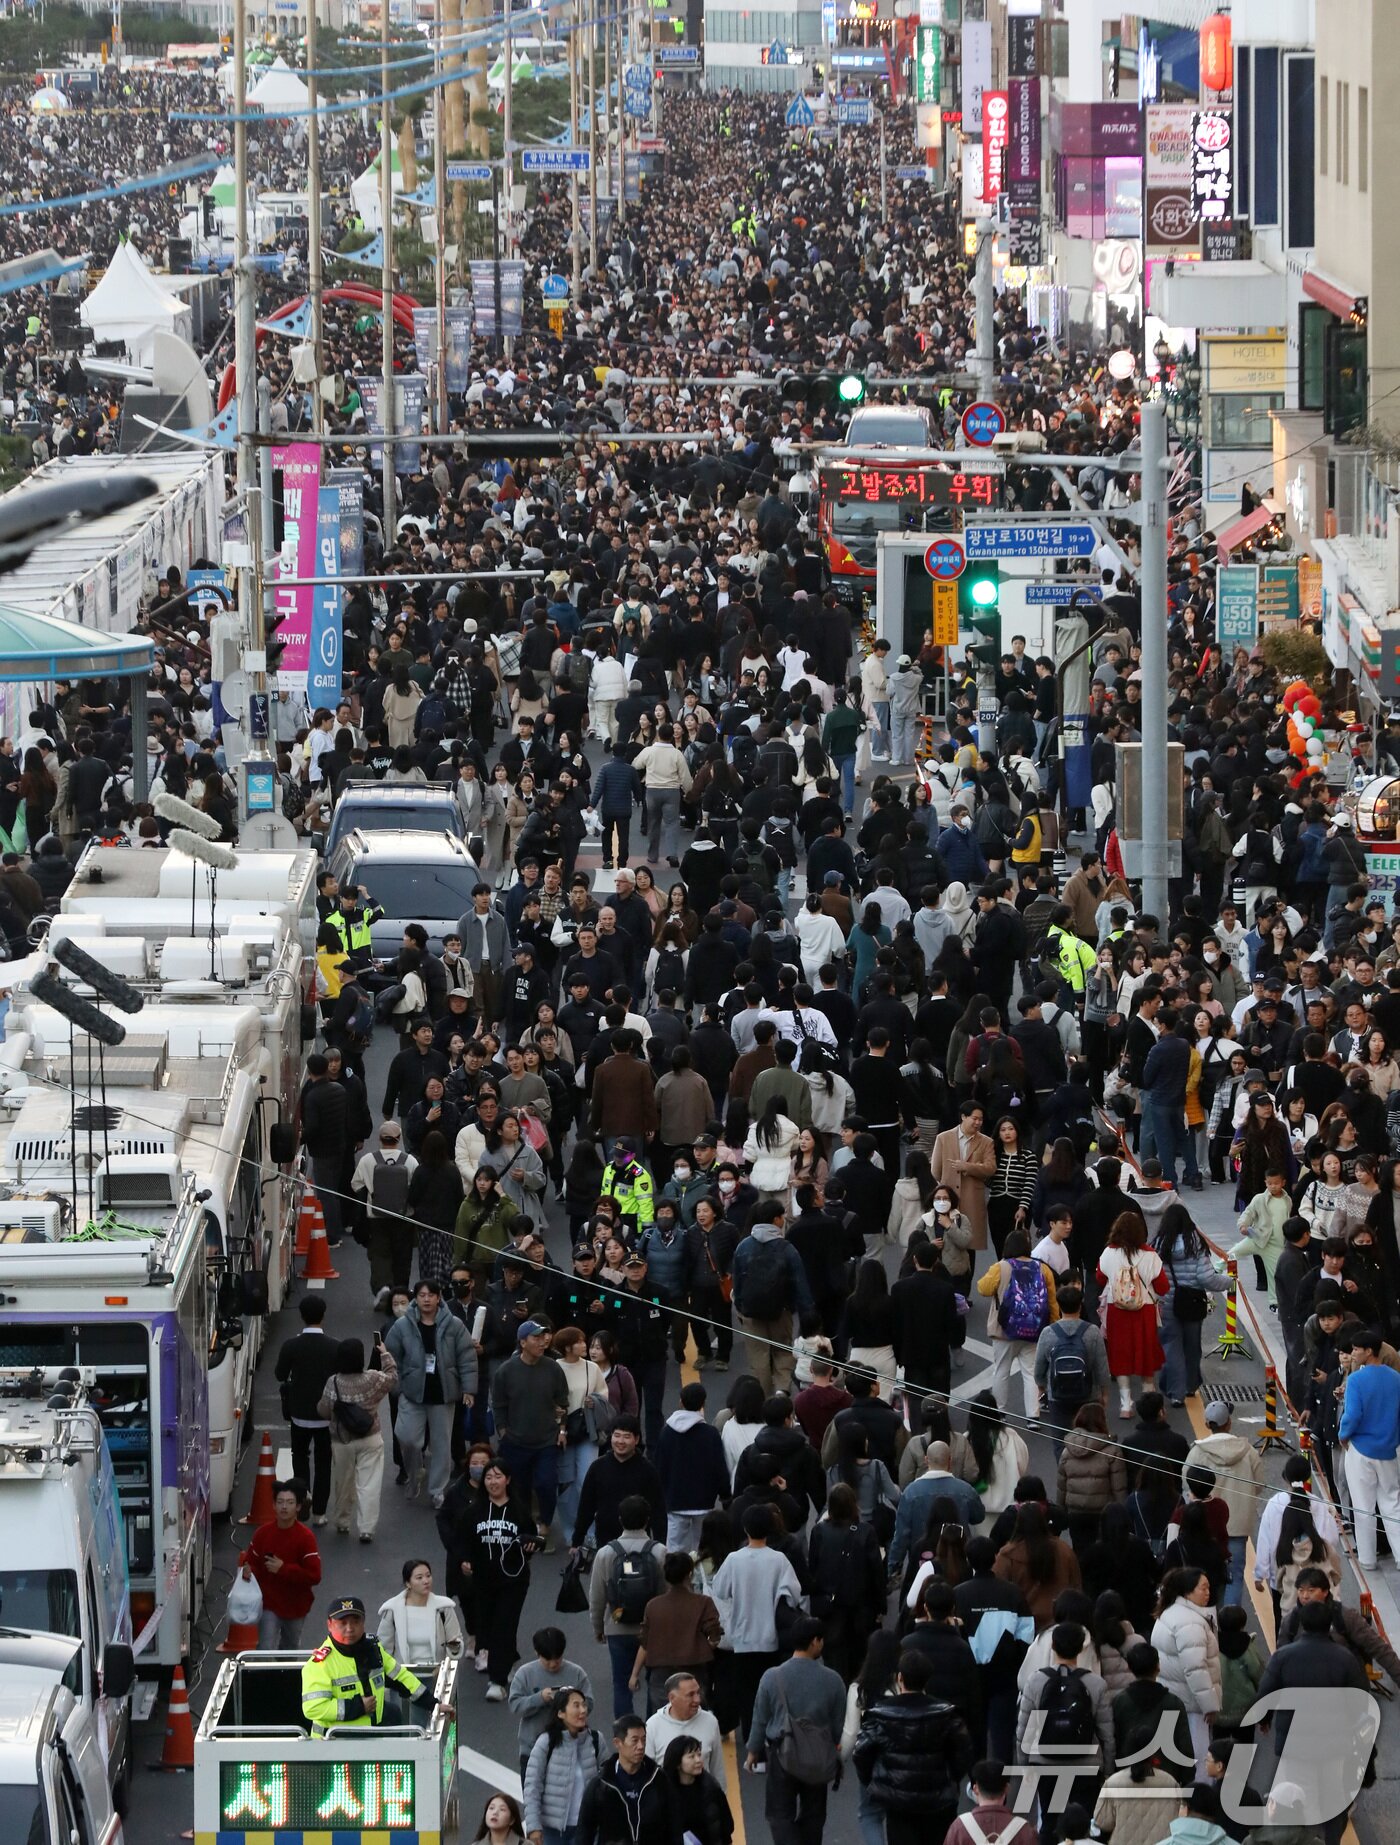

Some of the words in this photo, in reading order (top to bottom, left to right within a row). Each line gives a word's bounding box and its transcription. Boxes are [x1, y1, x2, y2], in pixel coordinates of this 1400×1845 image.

[1158, 142, 1189, 152] BEACH
[1161, 153, 1185, 163] PARK
[1233, 346, 1270, 358] HOTEL
[949, 473, 993, 505] 우회
[1069, 534, 1077, 543] 19
[969, 547, 1027, 556] Gwangnam-ro
[1029, 545, 1079, 555] 130beon-gil
[1230, 605, 1252, 620] 50
[1223, 621, 1252, 635] 할인
[277, 633, 307, 645] ENTRY
[980, 712, 996, 721] 207
[1366, 858, 1400, 871] -ELE
[476, 1519, 518, 1535] BROOKLYN
[223, 1762, 289, 1828] 서
